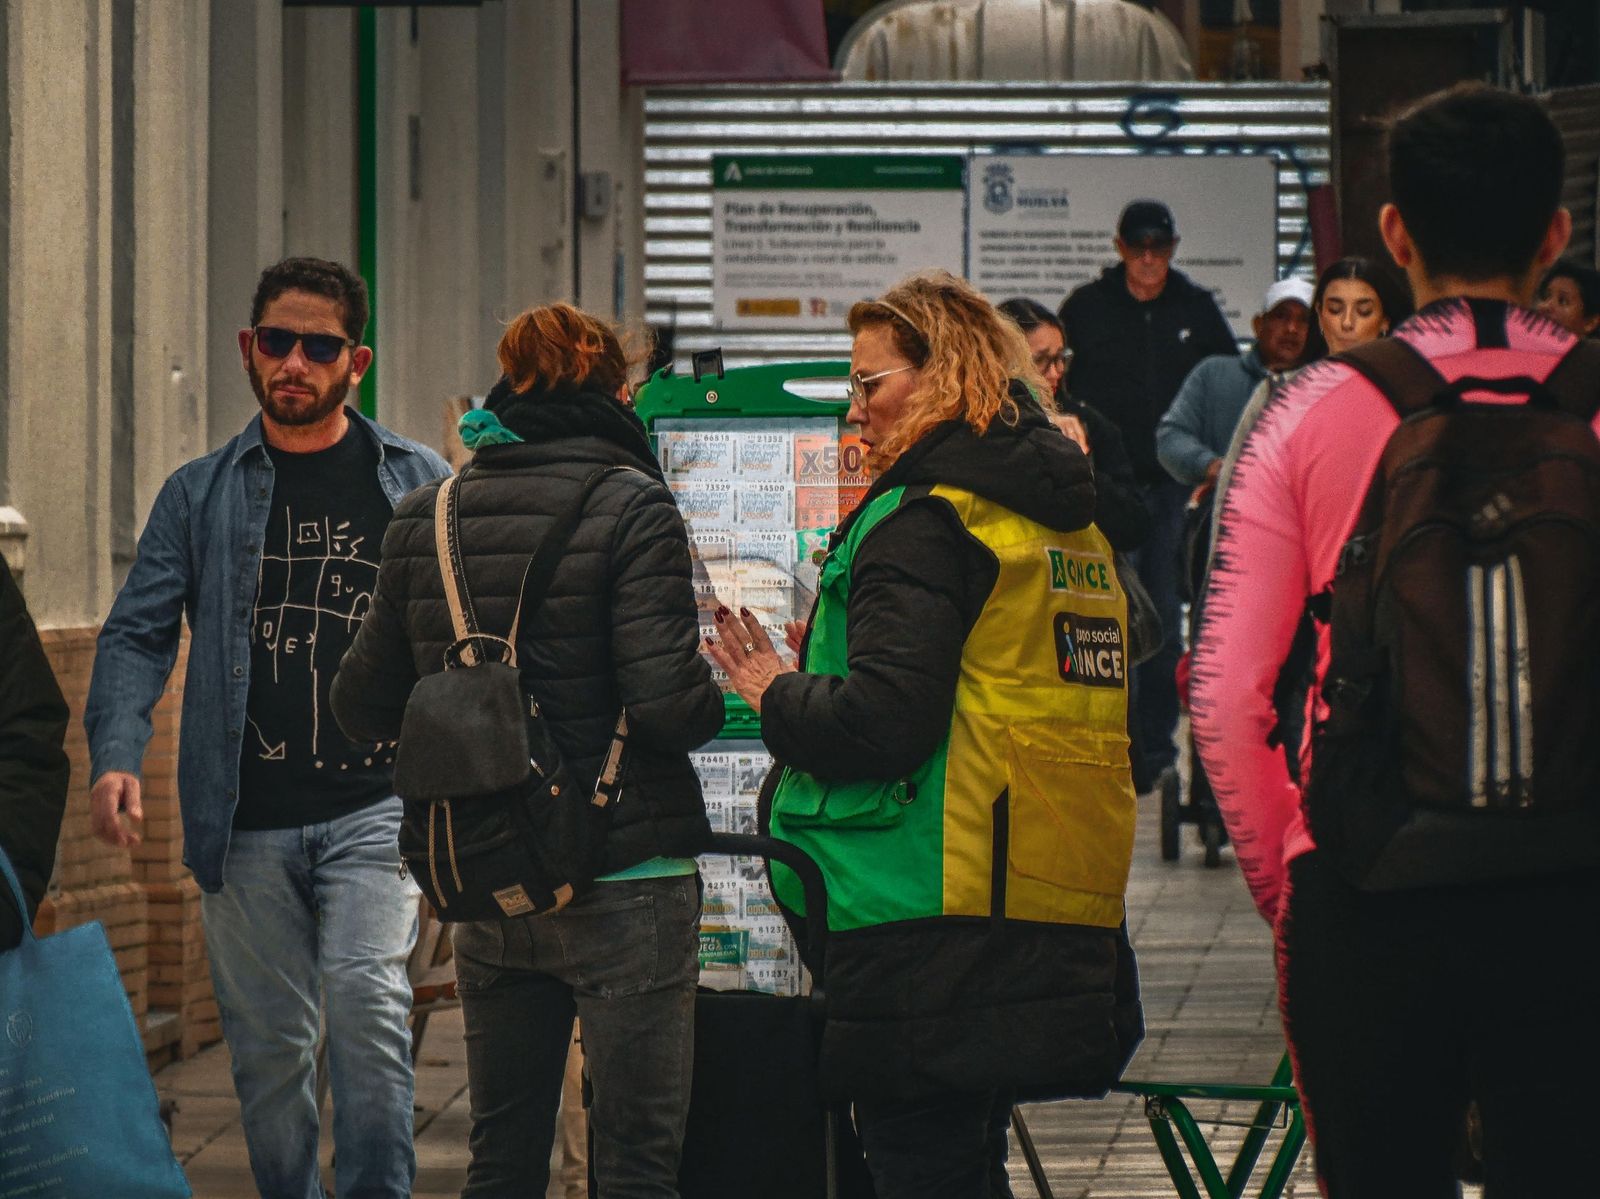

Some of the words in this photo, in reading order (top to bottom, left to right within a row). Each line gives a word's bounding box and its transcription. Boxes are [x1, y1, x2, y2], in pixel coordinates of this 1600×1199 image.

[723, 201, 753, 215] Plan
[757, 201, 774, 215] de
[1091, 626, 1121, 644] social
